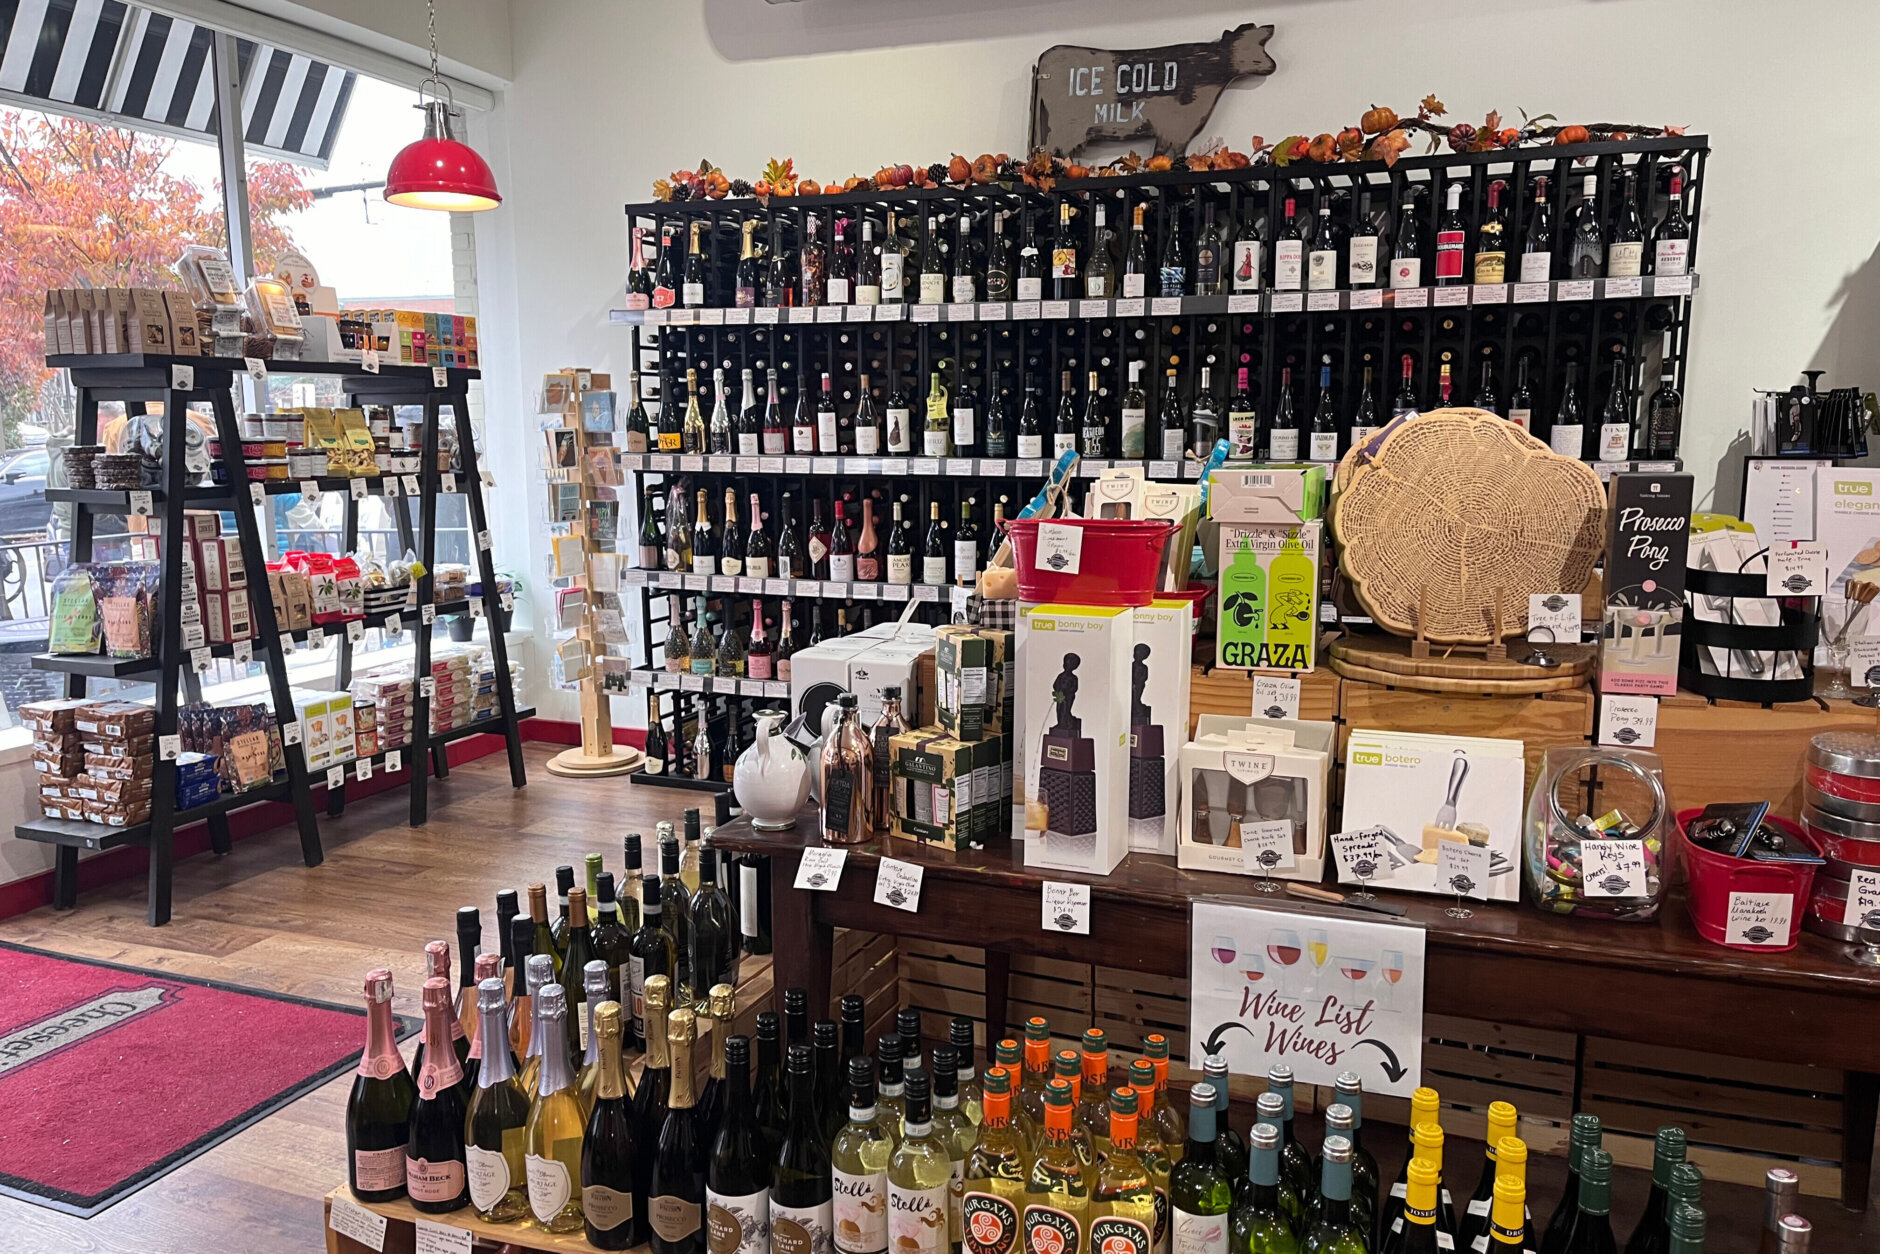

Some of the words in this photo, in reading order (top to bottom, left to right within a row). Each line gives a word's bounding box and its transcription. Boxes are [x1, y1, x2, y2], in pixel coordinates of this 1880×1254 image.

[1068, 67, 1104, 96] ICE
[1116, 62, 1178, 93] COLD
[1094, 101, 1144, 124] MILK
[1838, 483, 1868, 493] true
[1834, 499, 1880, 511] elegan
[1619, 507, 1686, 531] Prosecco
[1268, 529, 1276, 538] &
[1226, 538, 1248, 548] Extra
[1250, 539, 1276, 550] Virgin
[1278, 540, 1300, 549] Olive
[1301, 540, 1314, 549] Oil
[1627, 534, 1669, 571] Pong
[1157, 613, 1174, 623] boy
[1034, 620, 1054, 630] true
[1058, 619, 1085, 631] bonny
[1087, 621, 1103, 632] boy
[1222, 641, 1309, 669] GRAZA
[1355, 754, 1380, 763] true
[1385, 753, 1421, 764] botero
[905, 761, 936, 772] GALANTINO
[1231, 759, 1267, 770] TWINE
[1615, 841, 1640, 851] Wine
[1208, 854, 1235, 862] GOURMET
[1600, 852, 1625, 862] Keys
[1857, 876, 1876, 885] Red
[1239, 986, 1305, 1023] Wine
[1315, 995, 1375, 1036] List
[1264, 1021, 1345, 1066] Wines
[429, 1174, 452, 1182] BECK
[588, 1203, 618, 1212] PROSECCO
[655, 1213, 687, 1222] PROSECCO
[710, 1228, 726, 1239] LANE
[773, 1232, 804, 1246] ORCHARD
[777, 1241, 795, 1252] LANE
